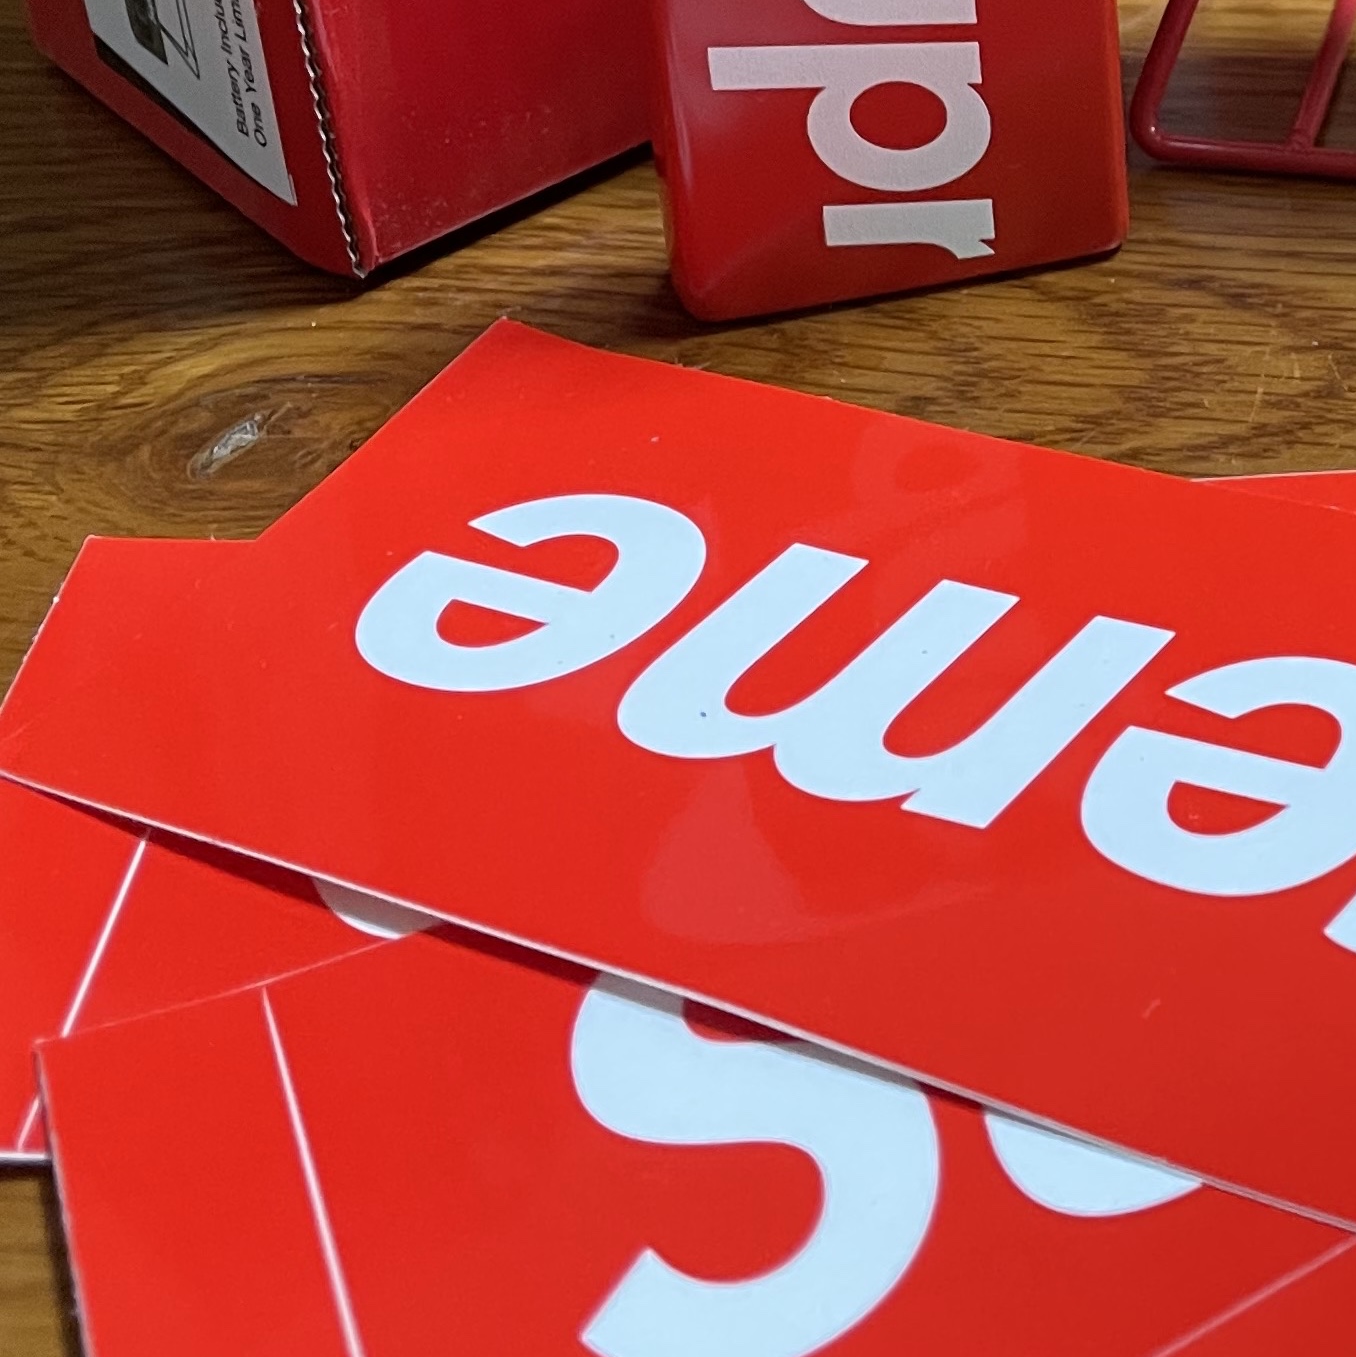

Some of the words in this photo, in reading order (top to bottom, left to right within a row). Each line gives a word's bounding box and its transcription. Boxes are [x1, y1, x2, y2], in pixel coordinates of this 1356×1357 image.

[239, 44, 258, 93] Year
[227, 59, 250, 138] Battery
[251, 102, 268, 148] One
